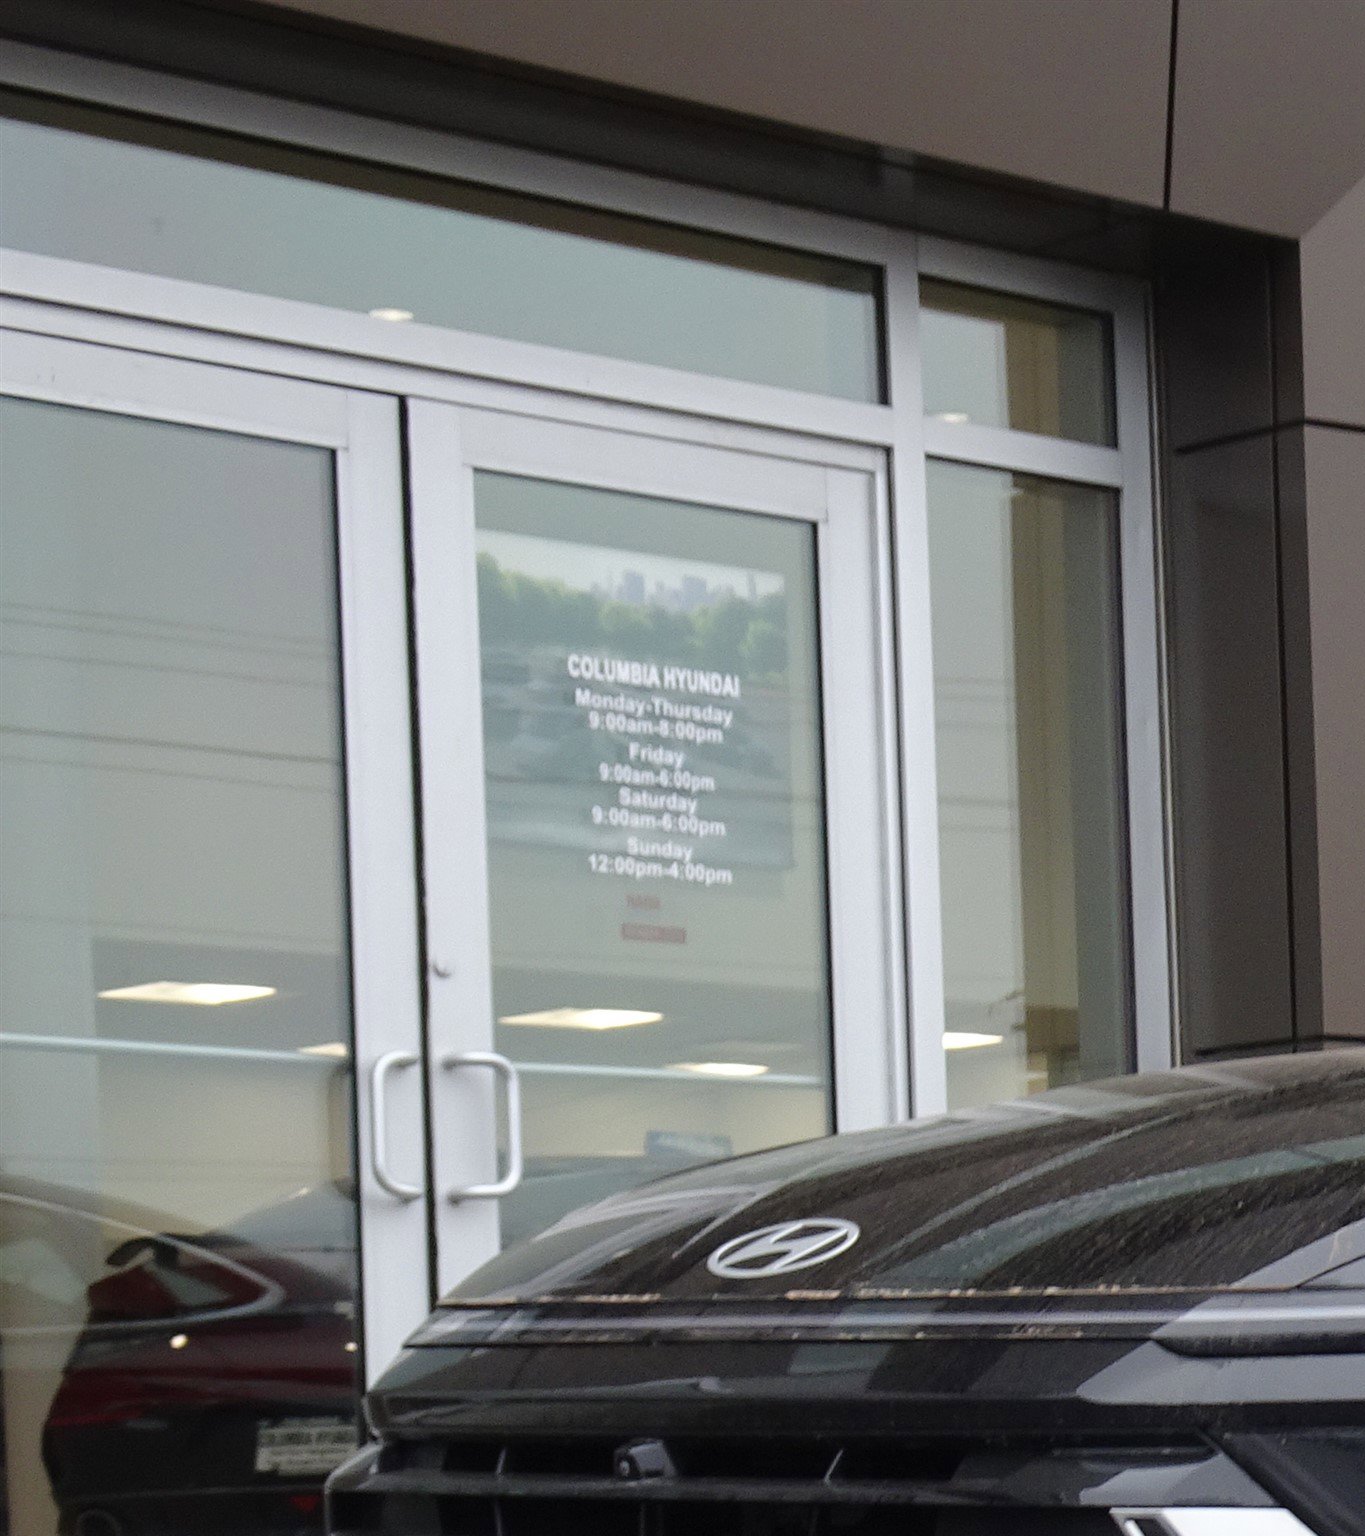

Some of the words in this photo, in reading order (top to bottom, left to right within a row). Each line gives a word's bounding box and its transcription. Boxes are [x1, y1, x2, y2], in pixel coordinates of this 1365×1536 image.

[567, 653, 661, 688] COLUMBIA
[663, 665, 741, 698] HYUNDAI
[575, 687, 733, 729] Monday-Thursday
[629, 741, 685, 769] Friday
[619, 786, 697, 815] Saturday
[627, 836, 692, 863] Sunday
[588, 853, 732, 886] 12:00pm-4:00pm
